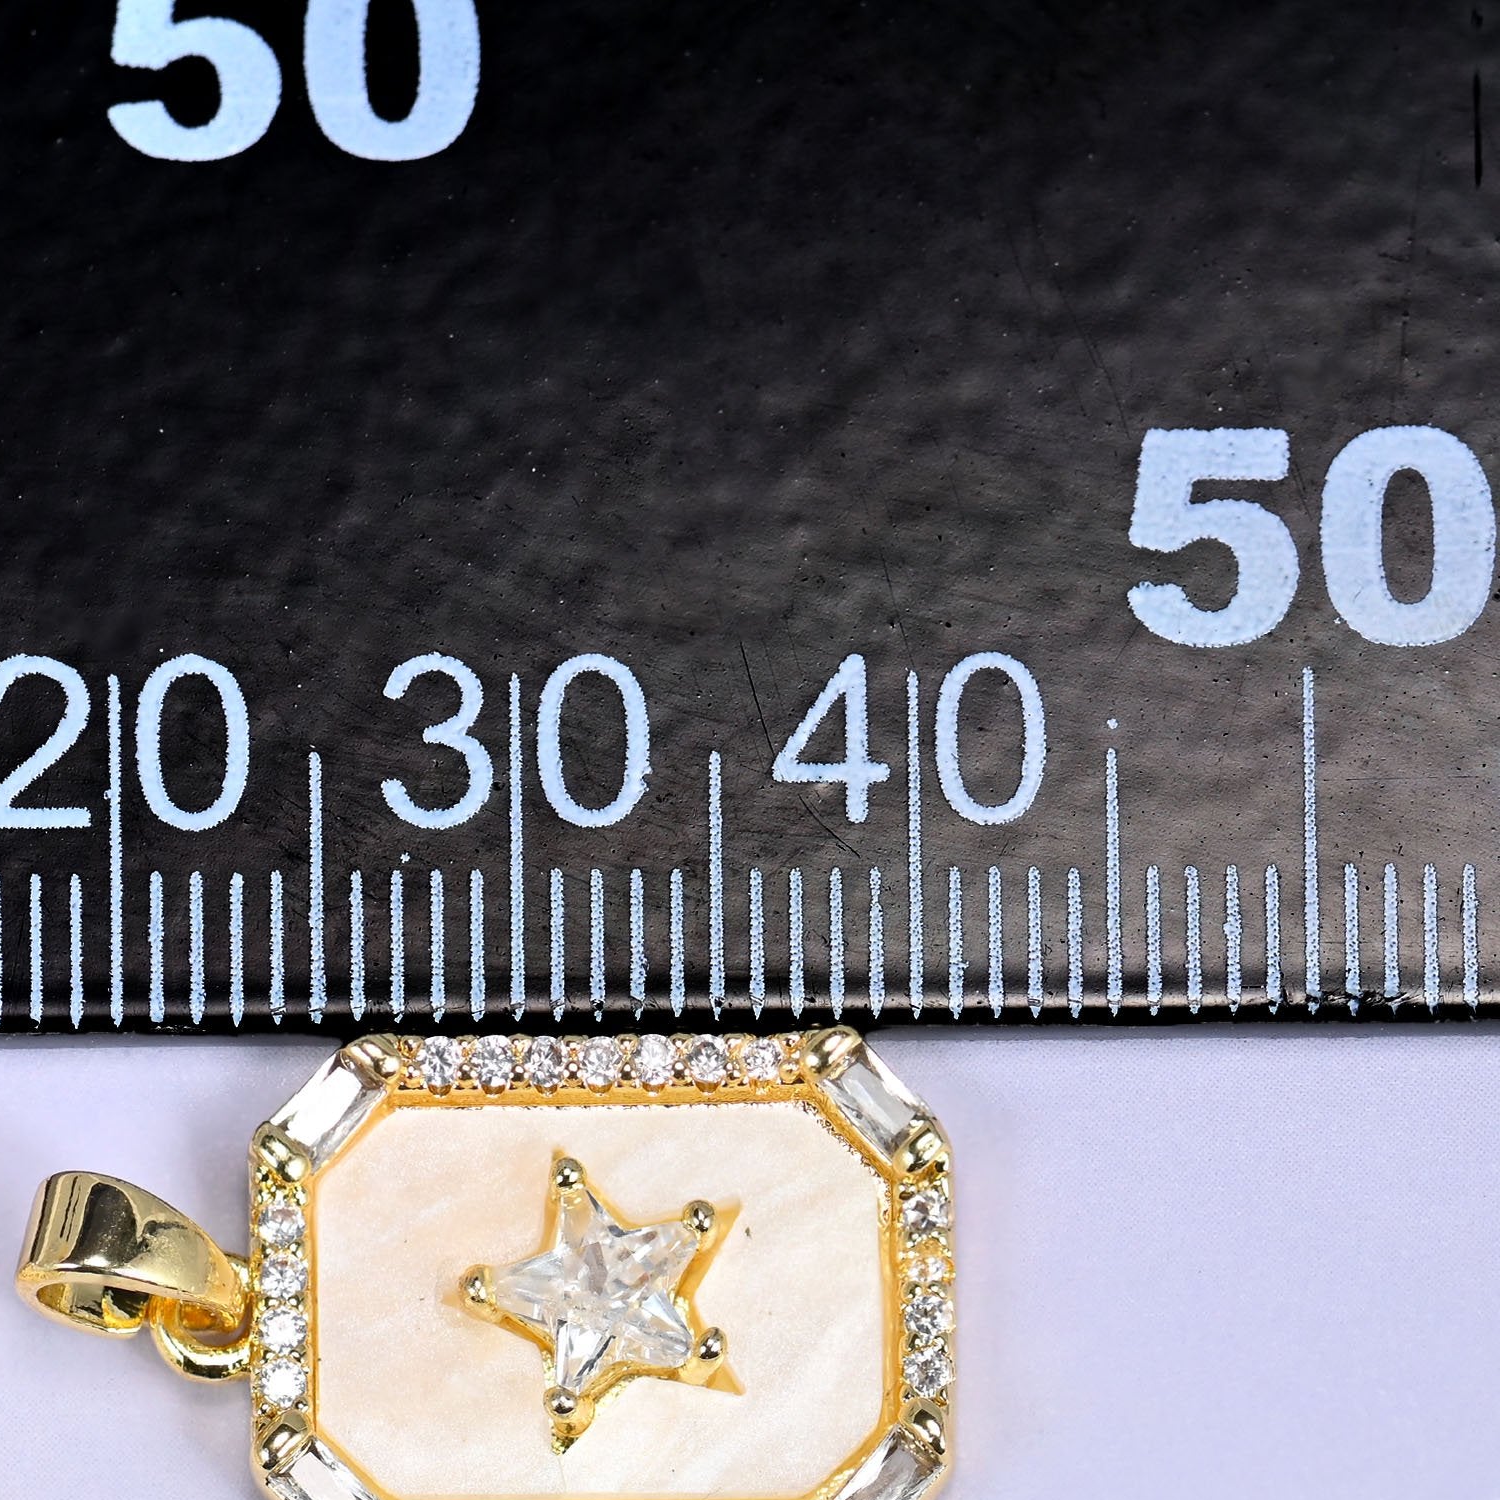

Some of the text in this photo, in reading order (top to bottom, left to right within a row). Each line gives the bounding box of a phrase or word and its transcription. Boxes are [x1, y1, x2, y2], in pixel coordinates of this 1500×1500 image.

[107, 0, 481, 163] 50
[1126, 424, 1498, 652] 50
[380, 650, 654, 831] 30
[770, 651, 1047, 825] 40
